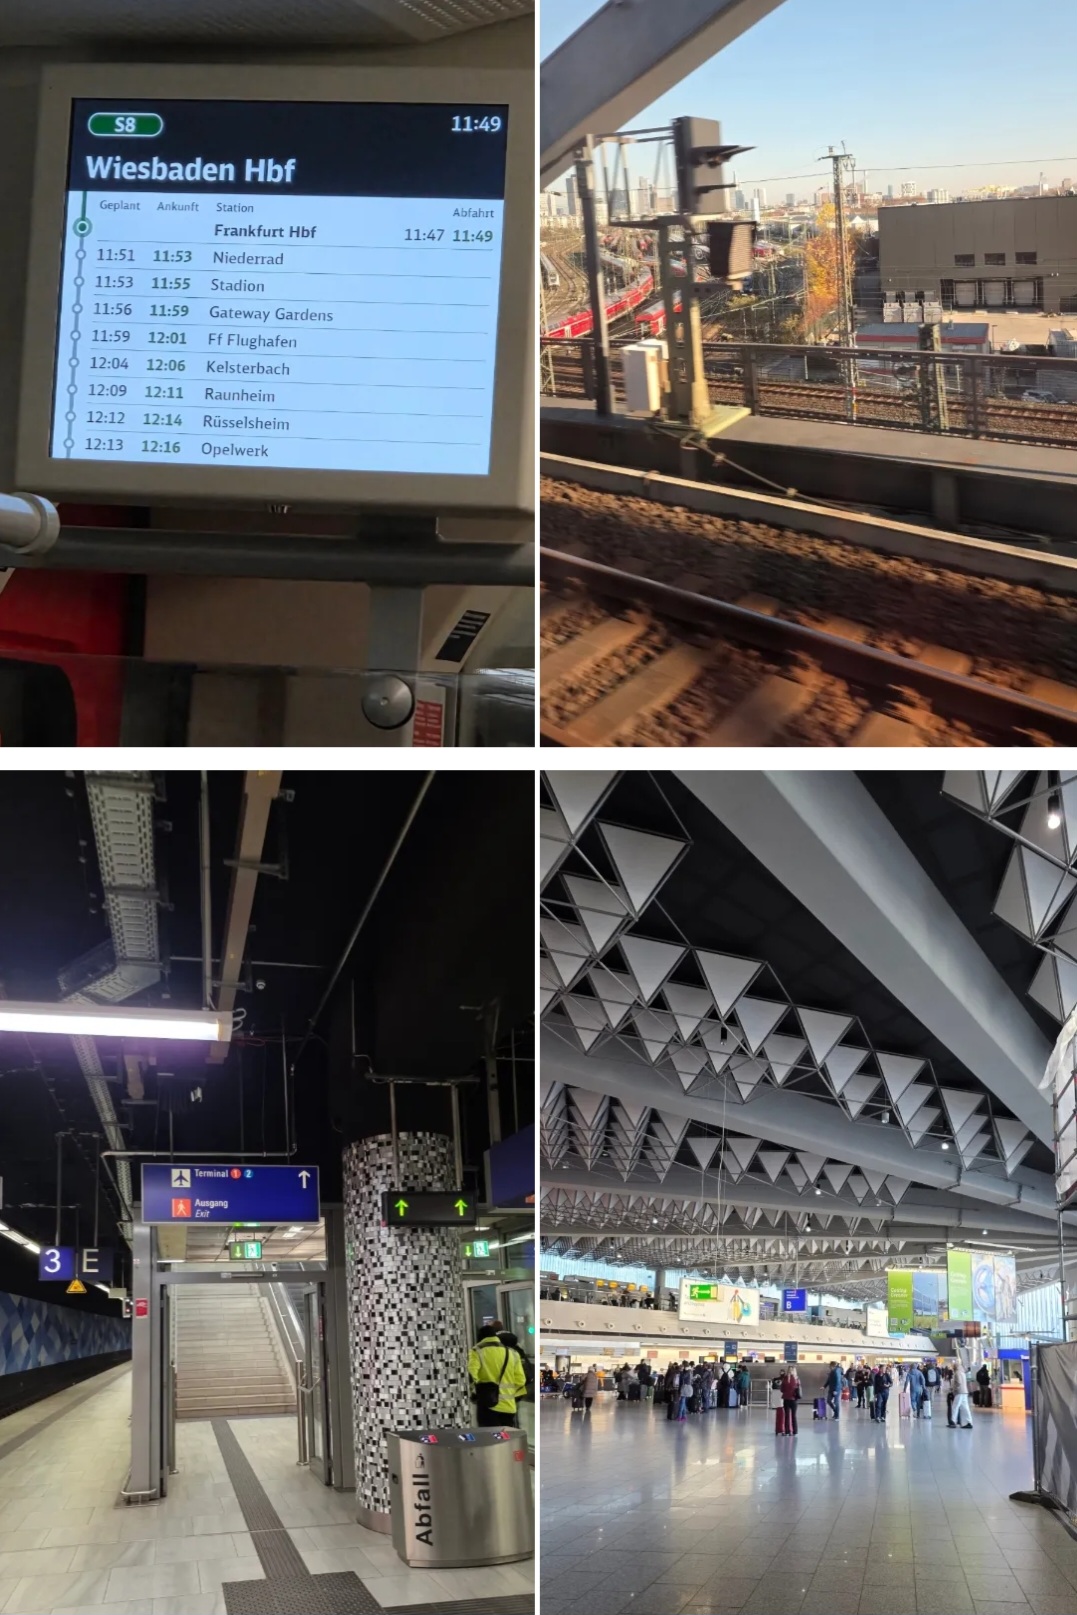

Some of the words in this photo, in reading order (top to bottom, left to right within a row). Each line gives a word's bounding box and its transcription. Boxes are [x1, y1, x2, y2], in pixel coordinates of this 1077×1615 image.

[114, 117, 136, 132] S8
[451, 116, 501, 132] 11:49
[86, 155, 235, 182] Wiesbaden
[245, 158, 297, 183] Hbf
[99, 200, 141, 211] Geplant
[156, 201, 199, 212] Ankunft
[216, 203, 254, 213] Station
[452, 208, 495, 218] Abfahrt
[214, 224, 284, 238] Frankfurt
[289, 226, 317, 239] Hbf
[404, 228, 445, 242] 11:47
[452, 229, 493, 243] 11:49
[96, 248, 136, 262] 11:51
[152, 250, 193, 264] 11:53
[213, 251, 284, 266] Niederrad
[95, 275, 134, 289] 11:53
[151, 277, 191, 291] 11:55
[210, 278, 265, 293] Stadion
[93, 302, 133, 316] 11:56
[149, 304, 190, 318] 11:59
[209, 305, 271, 323] Gateway
[275, 308, 334, 322] Gardens
[91, 329, 131, 343] 11:59
[148, 331, 187, 345] 12:01
[208, 332, 223, 346] Ff
[227, 333, 298, 350] Flughafen
[89, 356, 129, 371] 12:04
[146, 359, 186, 373] 12:06
[206, 360, 290, 376] Kelsterbach
[88, 383, 128, 398] 12:09
[144, 385, 184, 400] 12:11
[205, 387, 276, 403] Raunheim
[86, 411, 126, 425] 12:12
[143, 412, 183, 427] 12:14
[203, 414, 290, 431] Rüsselsheim
[84, 438, 124, 452] 12:13
[141, 440, 181, 454] 12:16
[201, 442, 269, 458] Opelwerk
[194, 1168, 229, 1178] Terminal
[245, 1169, 252, 1178] 2
[194, 1199, 229, 1209] Ausgang
[195, 1209, 210, 1218] Exit
[44, 1249, 62, 1273] 3
[82, 1249, 99, 1273] E
[786, 1301, 792, 1309] B
[412, 1474, 433, 1546] Abfall
